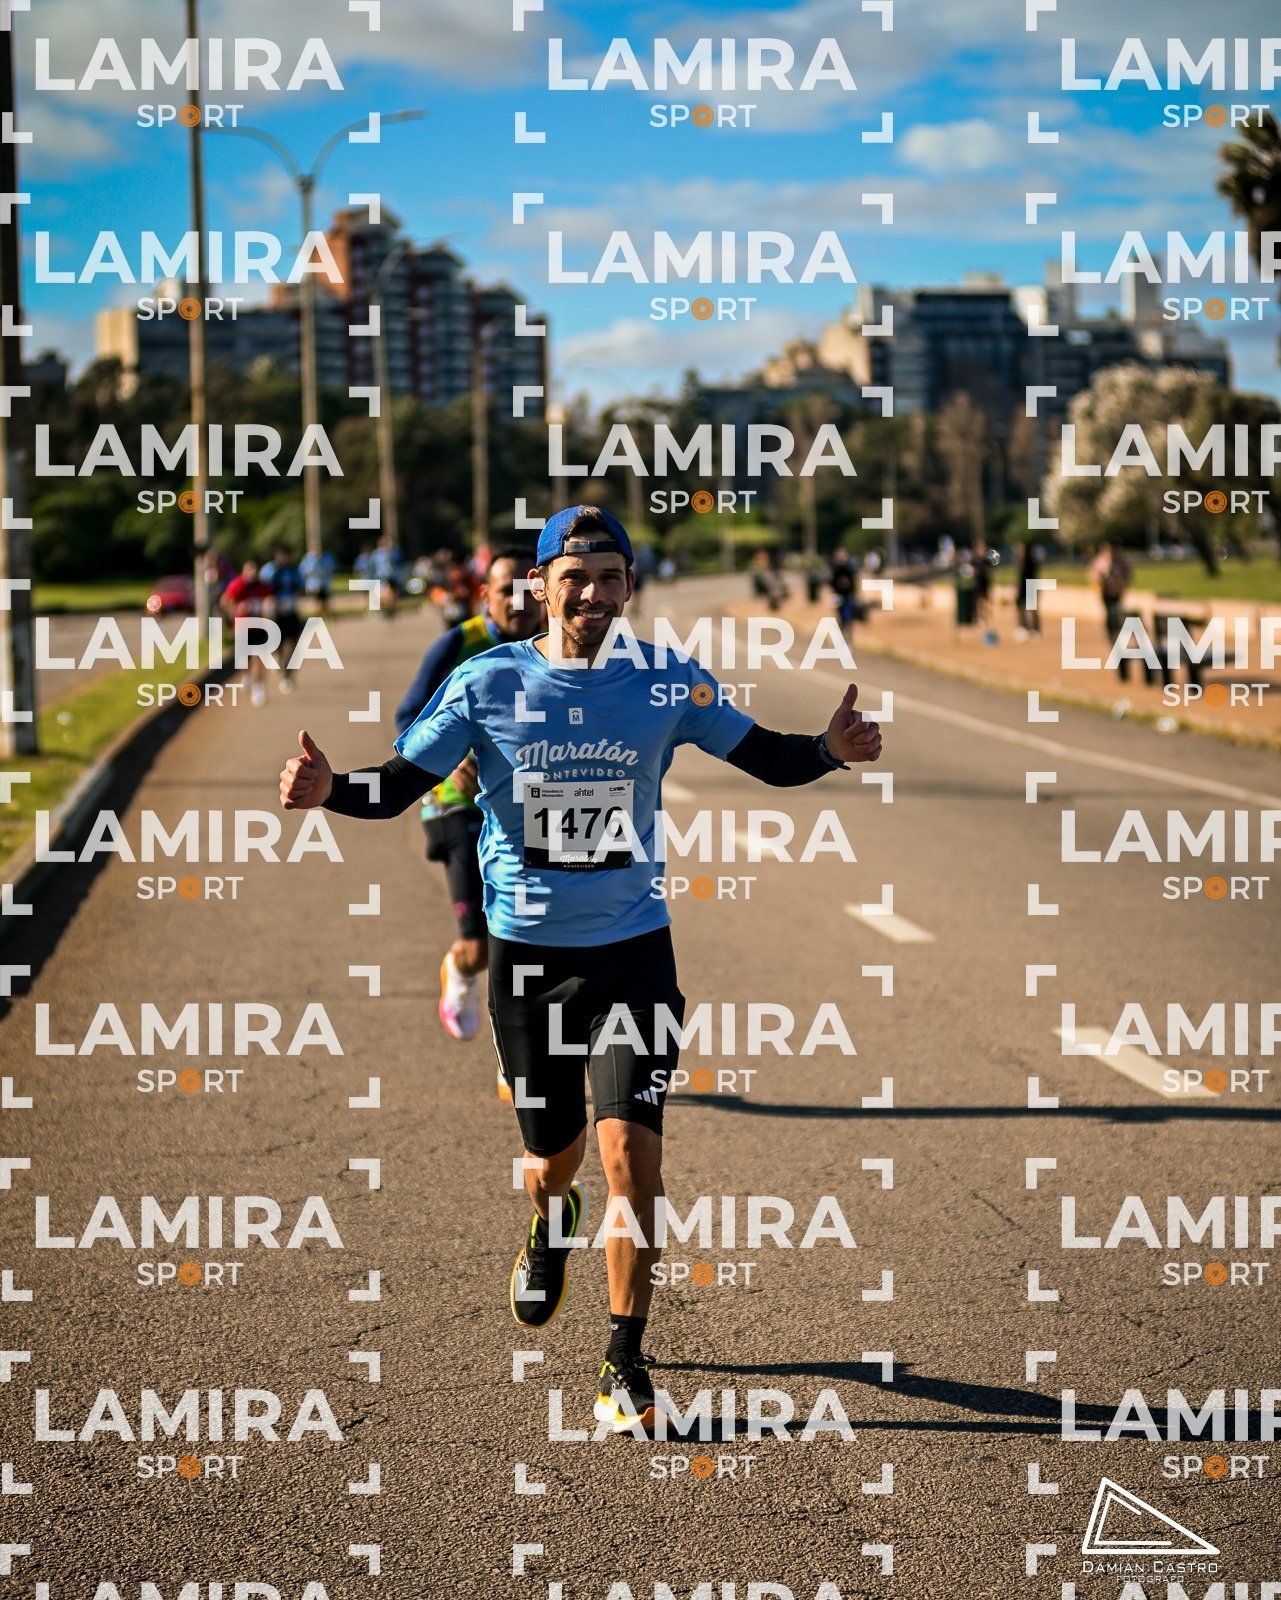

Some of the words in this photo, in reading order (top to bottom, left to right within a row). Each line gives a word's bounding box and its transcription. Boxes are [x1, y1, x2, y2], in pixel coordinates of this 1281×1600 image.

[515, 738, 639, 769] Maratón
[528, 768, 626, 781] MONTEVIDEO
[574, 788, 594, 797] antel
[534, 806, 625, 840] 1476
